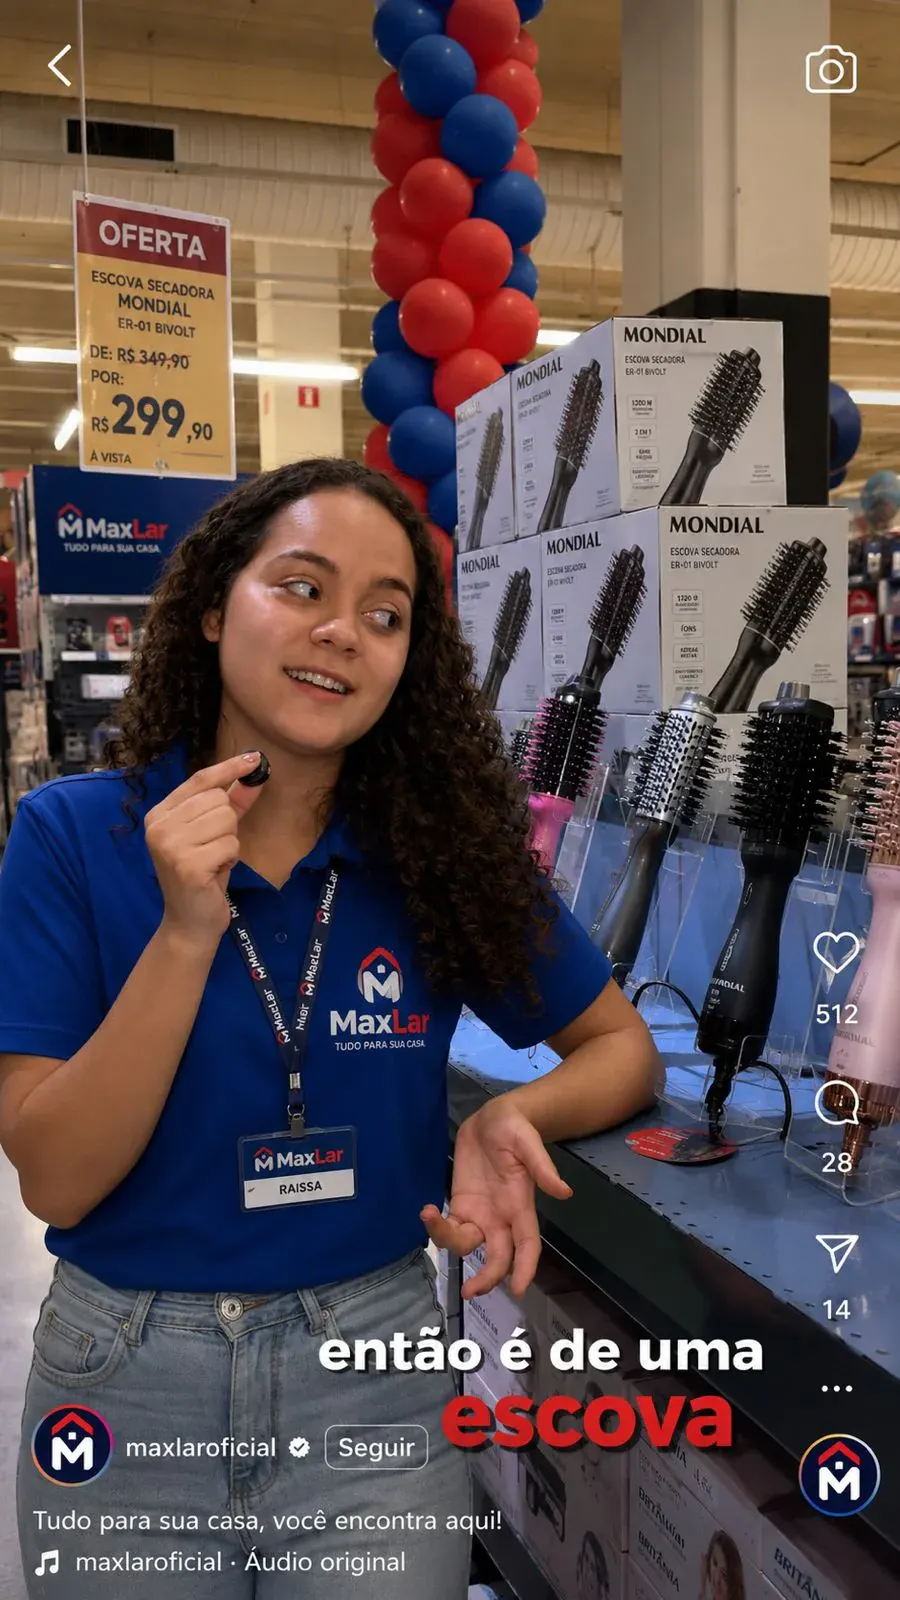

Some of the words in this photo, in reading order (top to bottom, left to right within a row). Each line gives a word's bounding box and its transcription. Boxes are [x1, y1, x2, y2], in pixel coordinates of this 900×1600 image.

[99, 219, 207, 261] OFERTA
[92, 270, 144, 290] ESCOVA
[148, 279, 215, 300] SECADORA
[118, 293, 192, 318] MONDIAL
[118, 318, 151, 332] ER-01
[156, 320, 196, 338] BIVOLT
[624, 326, 706, 343] MONDIAL
[90, 344, 113, 360] DE:
[139, 350, 189, 370] 349,90
[625, 355, 650, 364] ESCOVA
[652, 356, 686, 364] SECADORA
[91, 370, 124, 386] POR:
[517, 356, 563, 392] MONDIAL
[100, 451, 132, 464] VISTA
[86, 518, 168, 540] MaxLar
[670, 516, 764, 533] MONDIAL
[64, 543, 89, 552] TUDO
[91, 544, 114, 552] PARA
[116, 544, 134, 553] SUA
[136, 544, 160, 553] CASA
[546, 531, 601, 555] MONDIAL
[670, 547, 699, 556] ESCOVA
[701, 547, 740, 556] SECADORA
[461, 555, 500, 574] MONDIAL
[330, 1008, 430, 1036] MaxLar
[335, 1042, 362, 1051] TUDO
[364, 1040, 389, 1050] PARA
[389, 1040, 405, 1048] SUA
[406, 1040, 426, 1048] CASA
[276, 1148, 344, 1168] MaxLar
[279, 1180, 322, 1196] RAISSA
